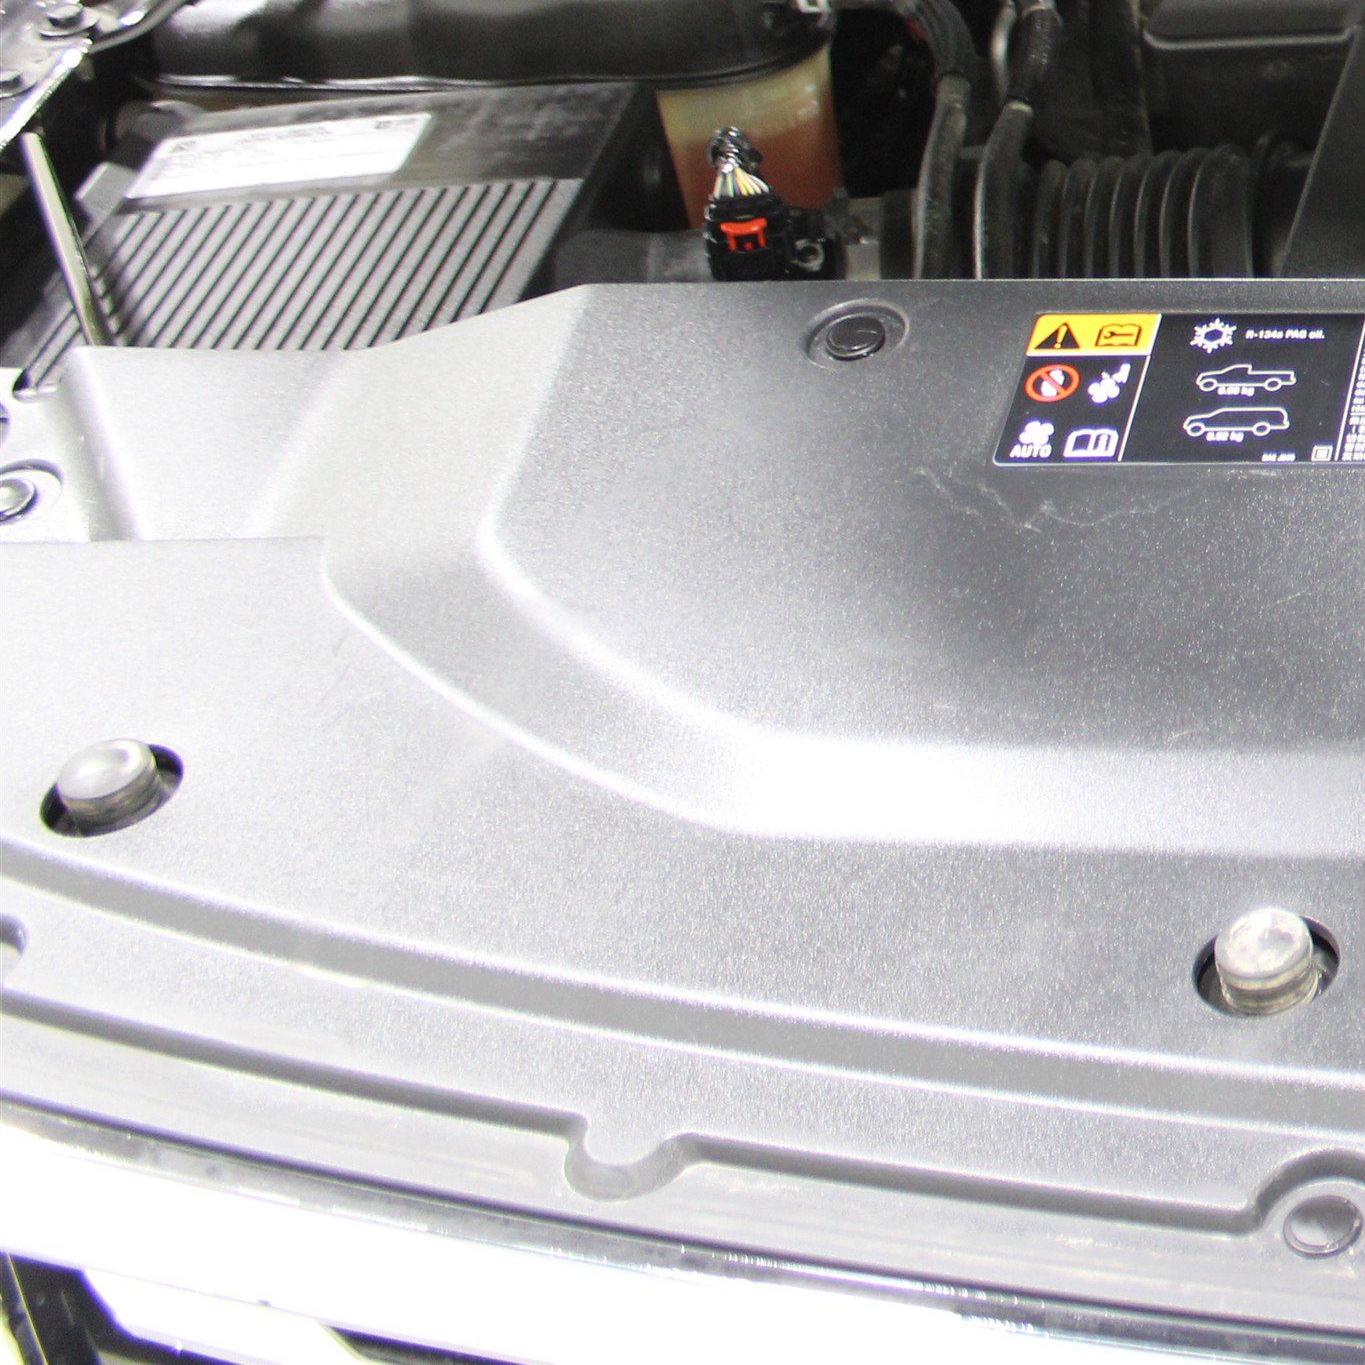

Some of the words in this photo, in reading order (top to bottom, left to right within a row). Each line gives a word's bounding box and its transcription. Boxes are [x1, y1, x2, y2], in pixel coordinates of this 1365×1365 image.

[1246, 330, 1283, 339] R-134a
[1285, 330, 1306, 339] PAG
[1309, 330, 1325, 339] oil.
[1010, 444, 1052, 457] AUTO
